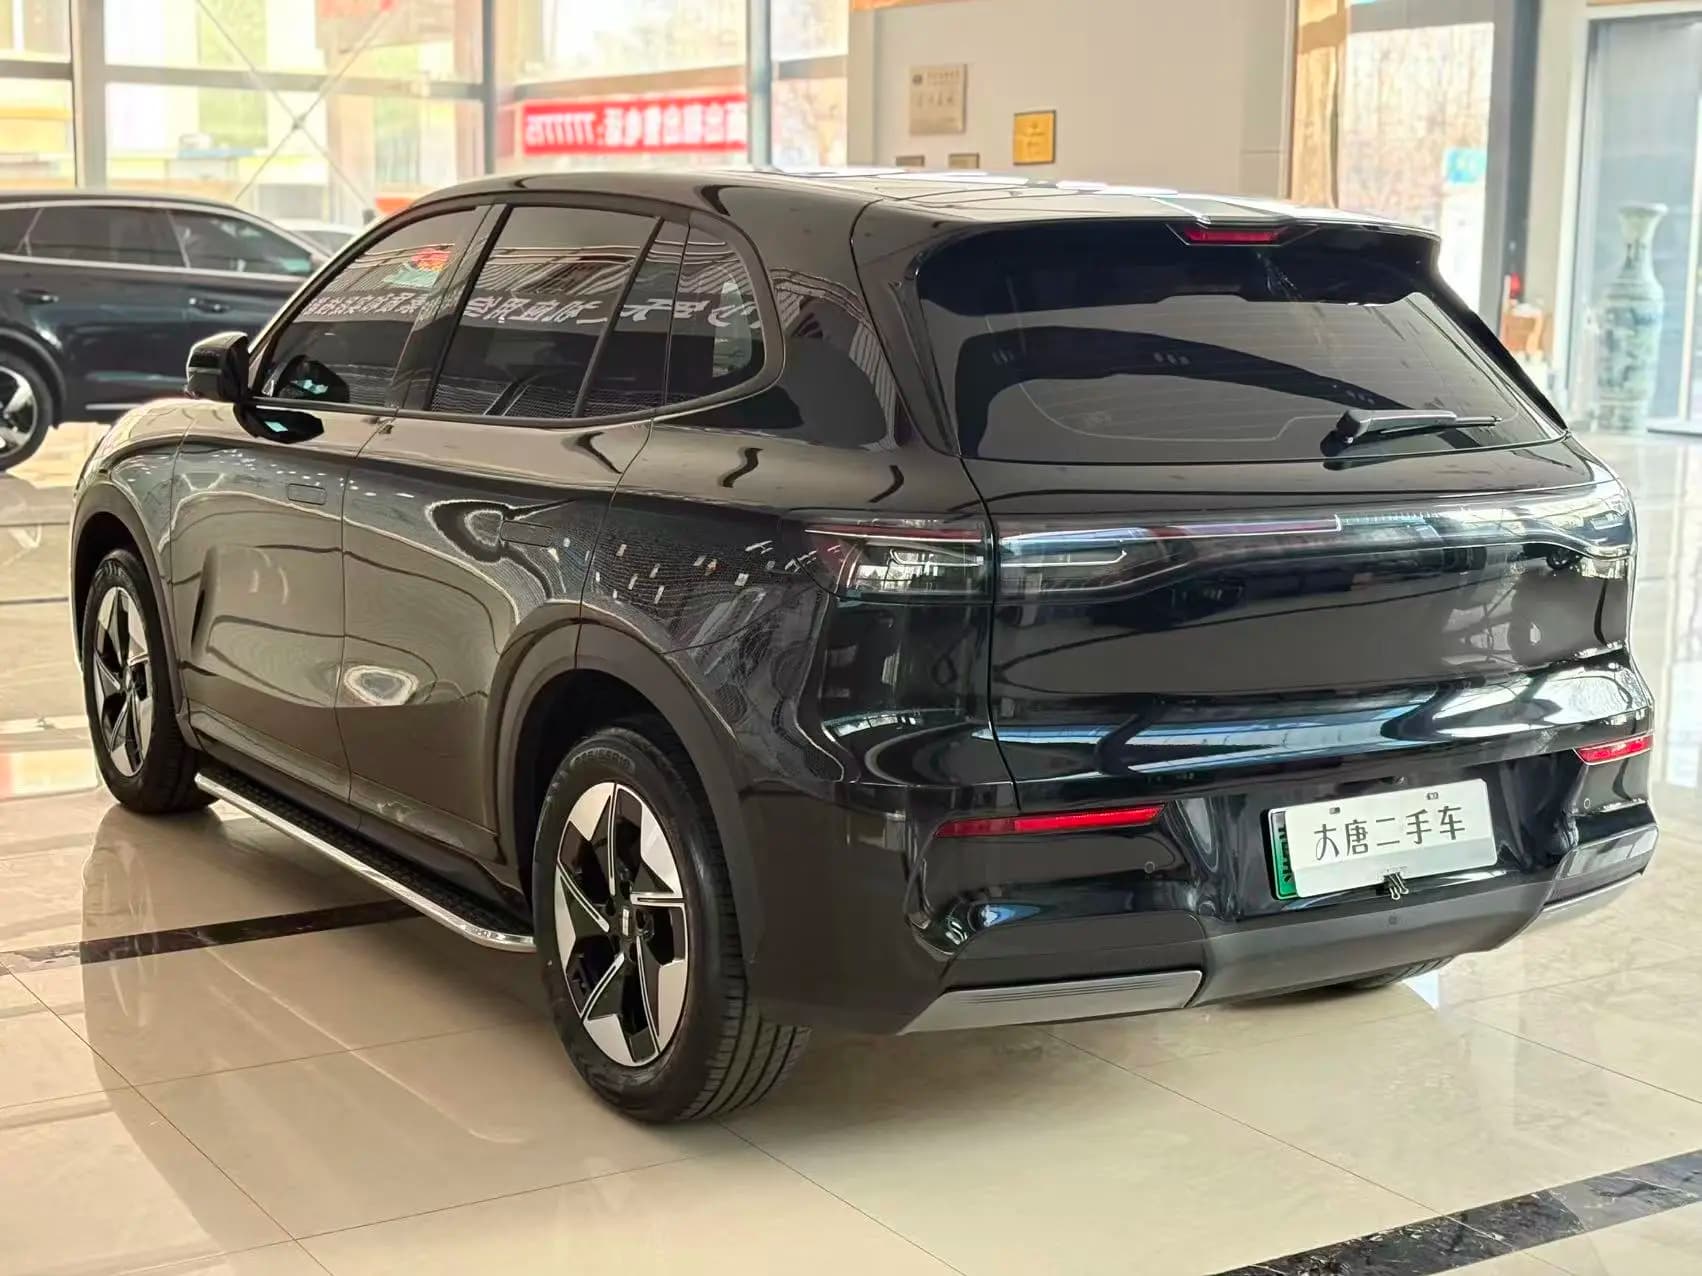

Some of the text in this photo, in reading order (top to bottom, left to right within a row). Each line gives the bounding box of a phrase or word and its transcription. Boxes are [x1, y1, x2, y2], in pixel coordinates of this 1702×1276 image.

[1314, 805, 1466, 861] 大唐二手车
